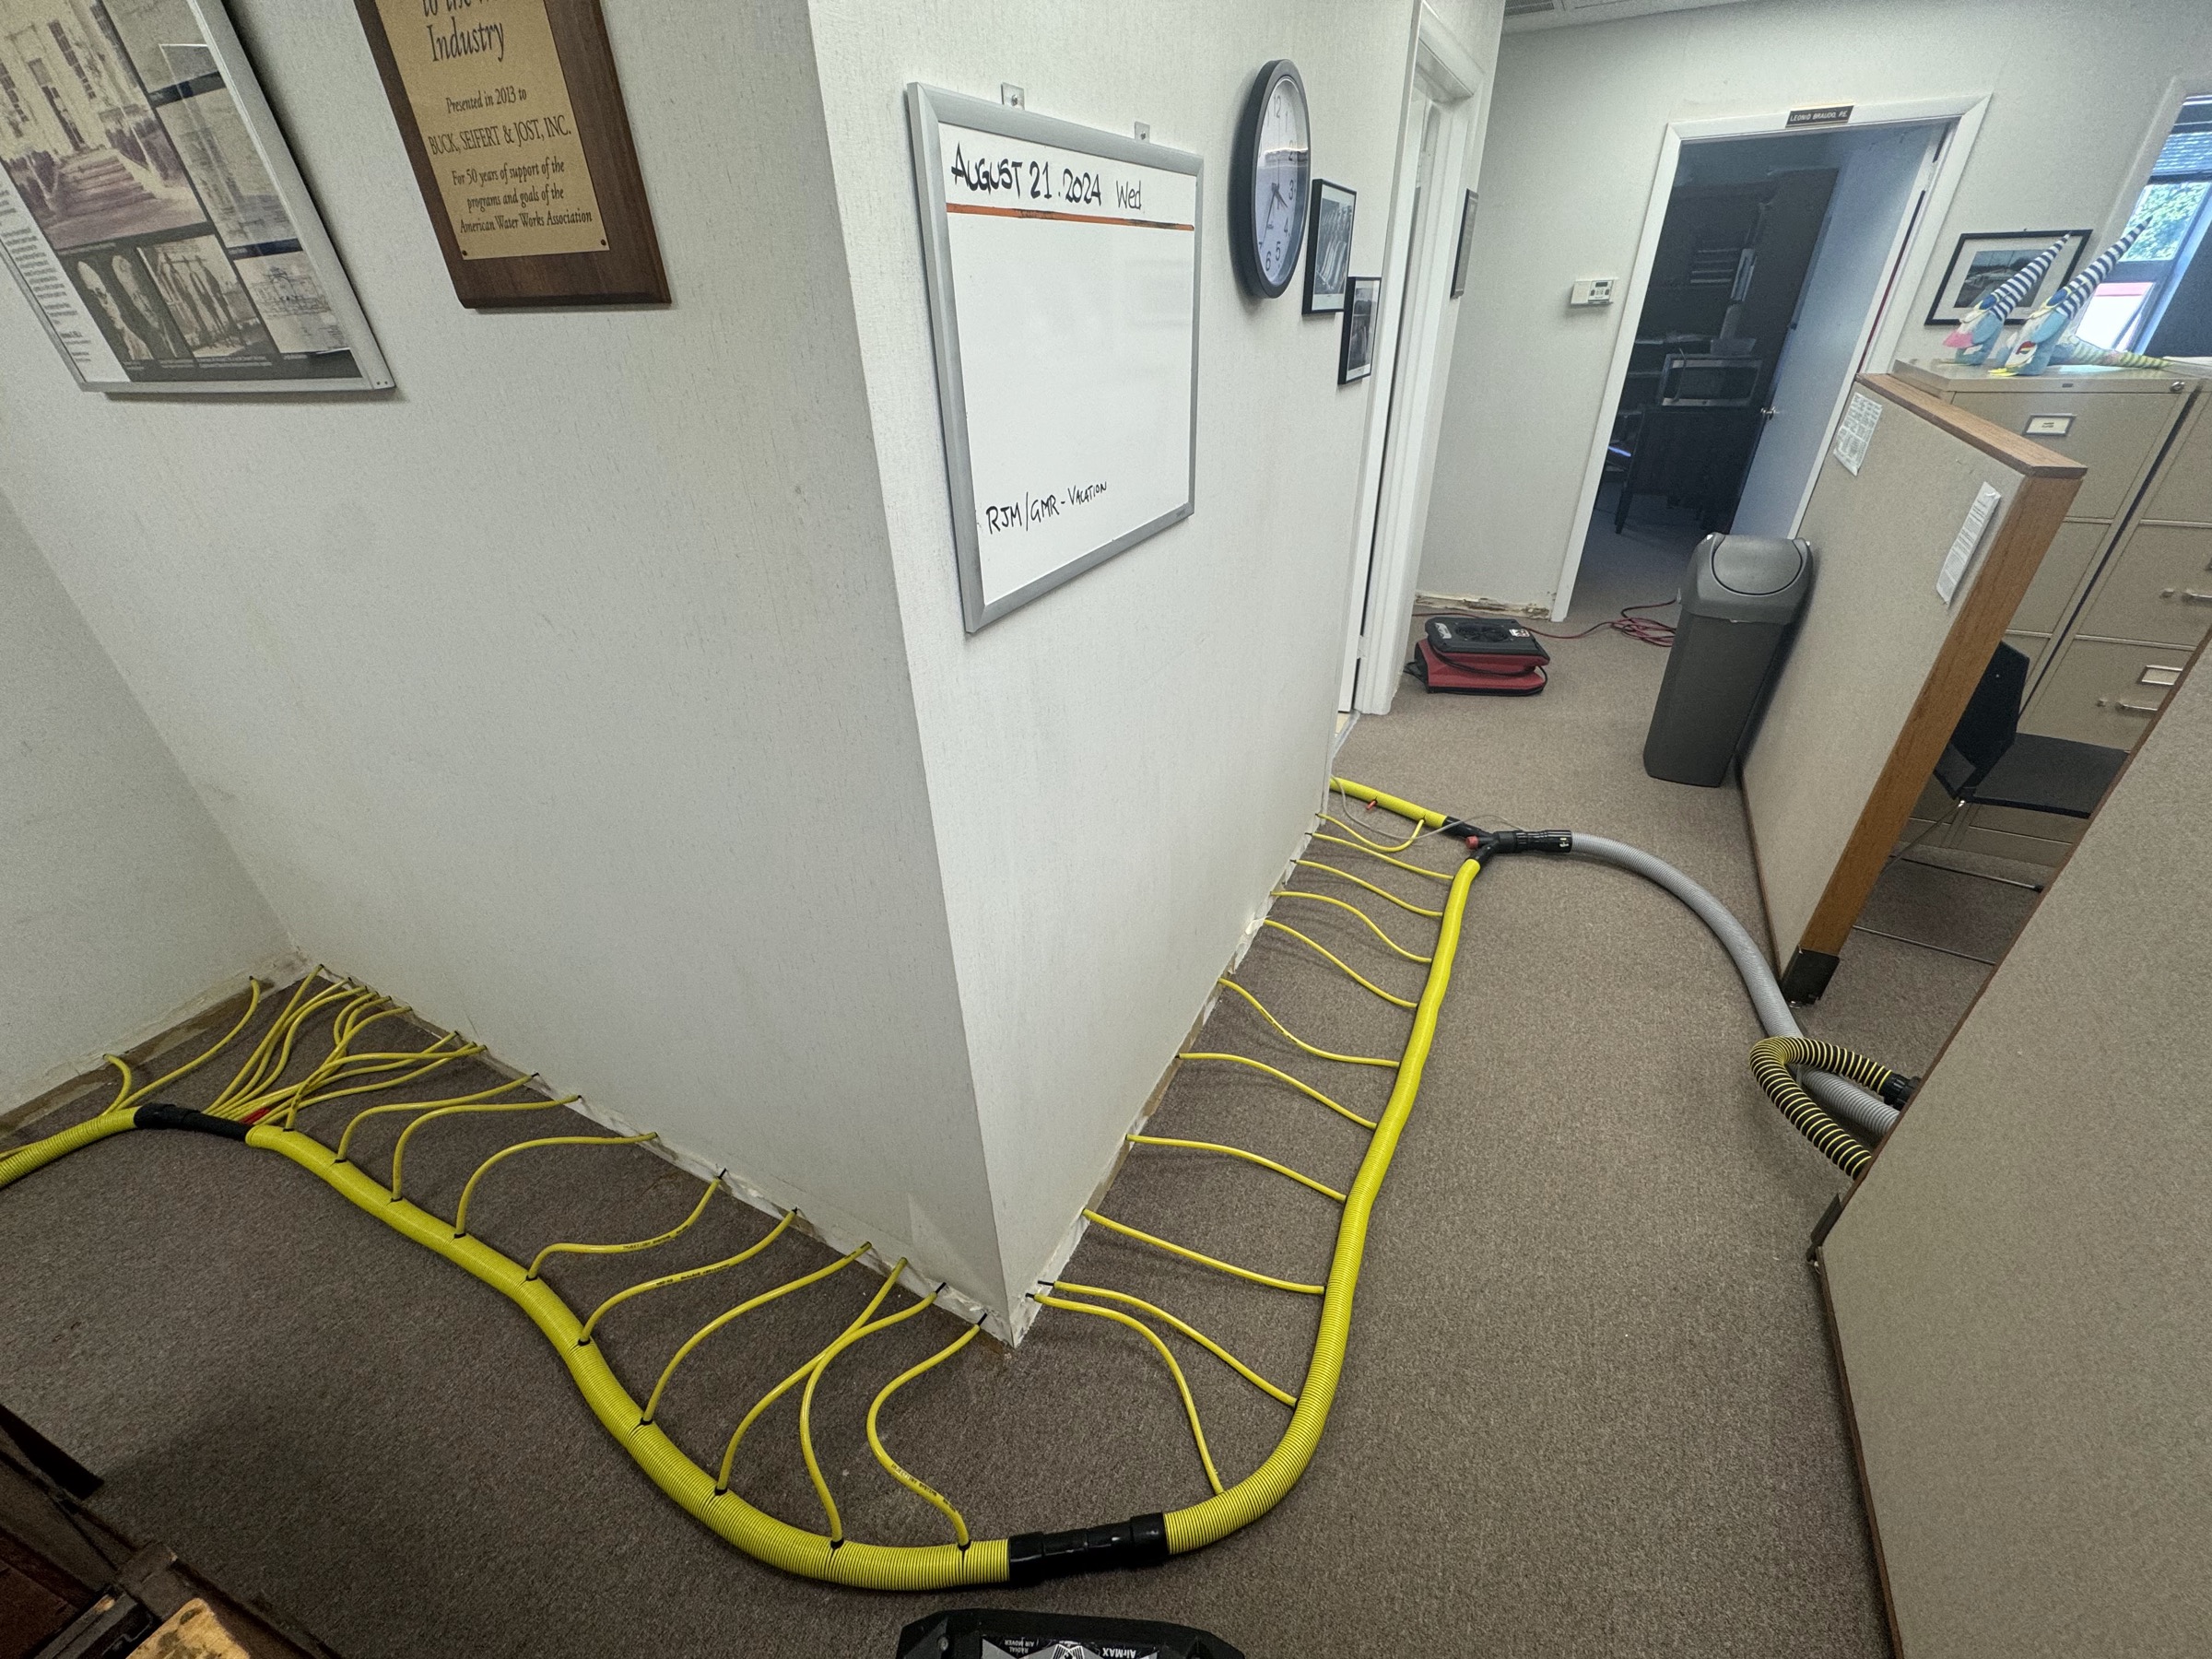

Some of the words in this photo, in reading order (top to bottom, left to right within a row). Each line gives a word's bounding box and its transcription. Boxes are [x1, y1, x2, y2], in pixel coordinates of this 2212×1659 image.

[426, 16, 504, 63] Industry
[446, 90, 484, 113] Presented
[484, 90, 494, 107] in
[495, 85, 517, 105] 2013
[519, 88, 527, 101] to
[1273, 94, 1281, 119] 12
[428, 133, 460, 155] BUCK,
[460, 125, 501, 150] SEIFERT
[501, 125, 515, 144] &
[513, 119, 545, 147] JOST,
[544, 114, 571, 137] INC.
[452, 171, 465, 185] For
[466, 169, 477, 184] 50
[478, 170, 499, 187] years
[500, 162, 508, 184] of
[510, 164, 539, 183] support
[542, 157, 550, 180] of
[551, 156, 565, 174] the
[951, 142, 1023, 199] AUGUST
[466, 195, 501, 213] programs
[503, 188, 519, 205] and
[520, 185, 540, 208] goals
[541, 183, 549, 206] of
[551, 182, 564, 199] the
[1289, 180, 1294, 201] 3
[460, 218, 496, 233] American
[495, 215, 519, 230] Water
[519, 211, 545, 228] Works
[547, 208, 593, 227] Association
[1284, 217, 1288, 237] 4
[1265, 251, 1272, 272] 6
[1275, 241, 1280, 262] 5
[1102, 1647, 1136, 1659] AirMAX
